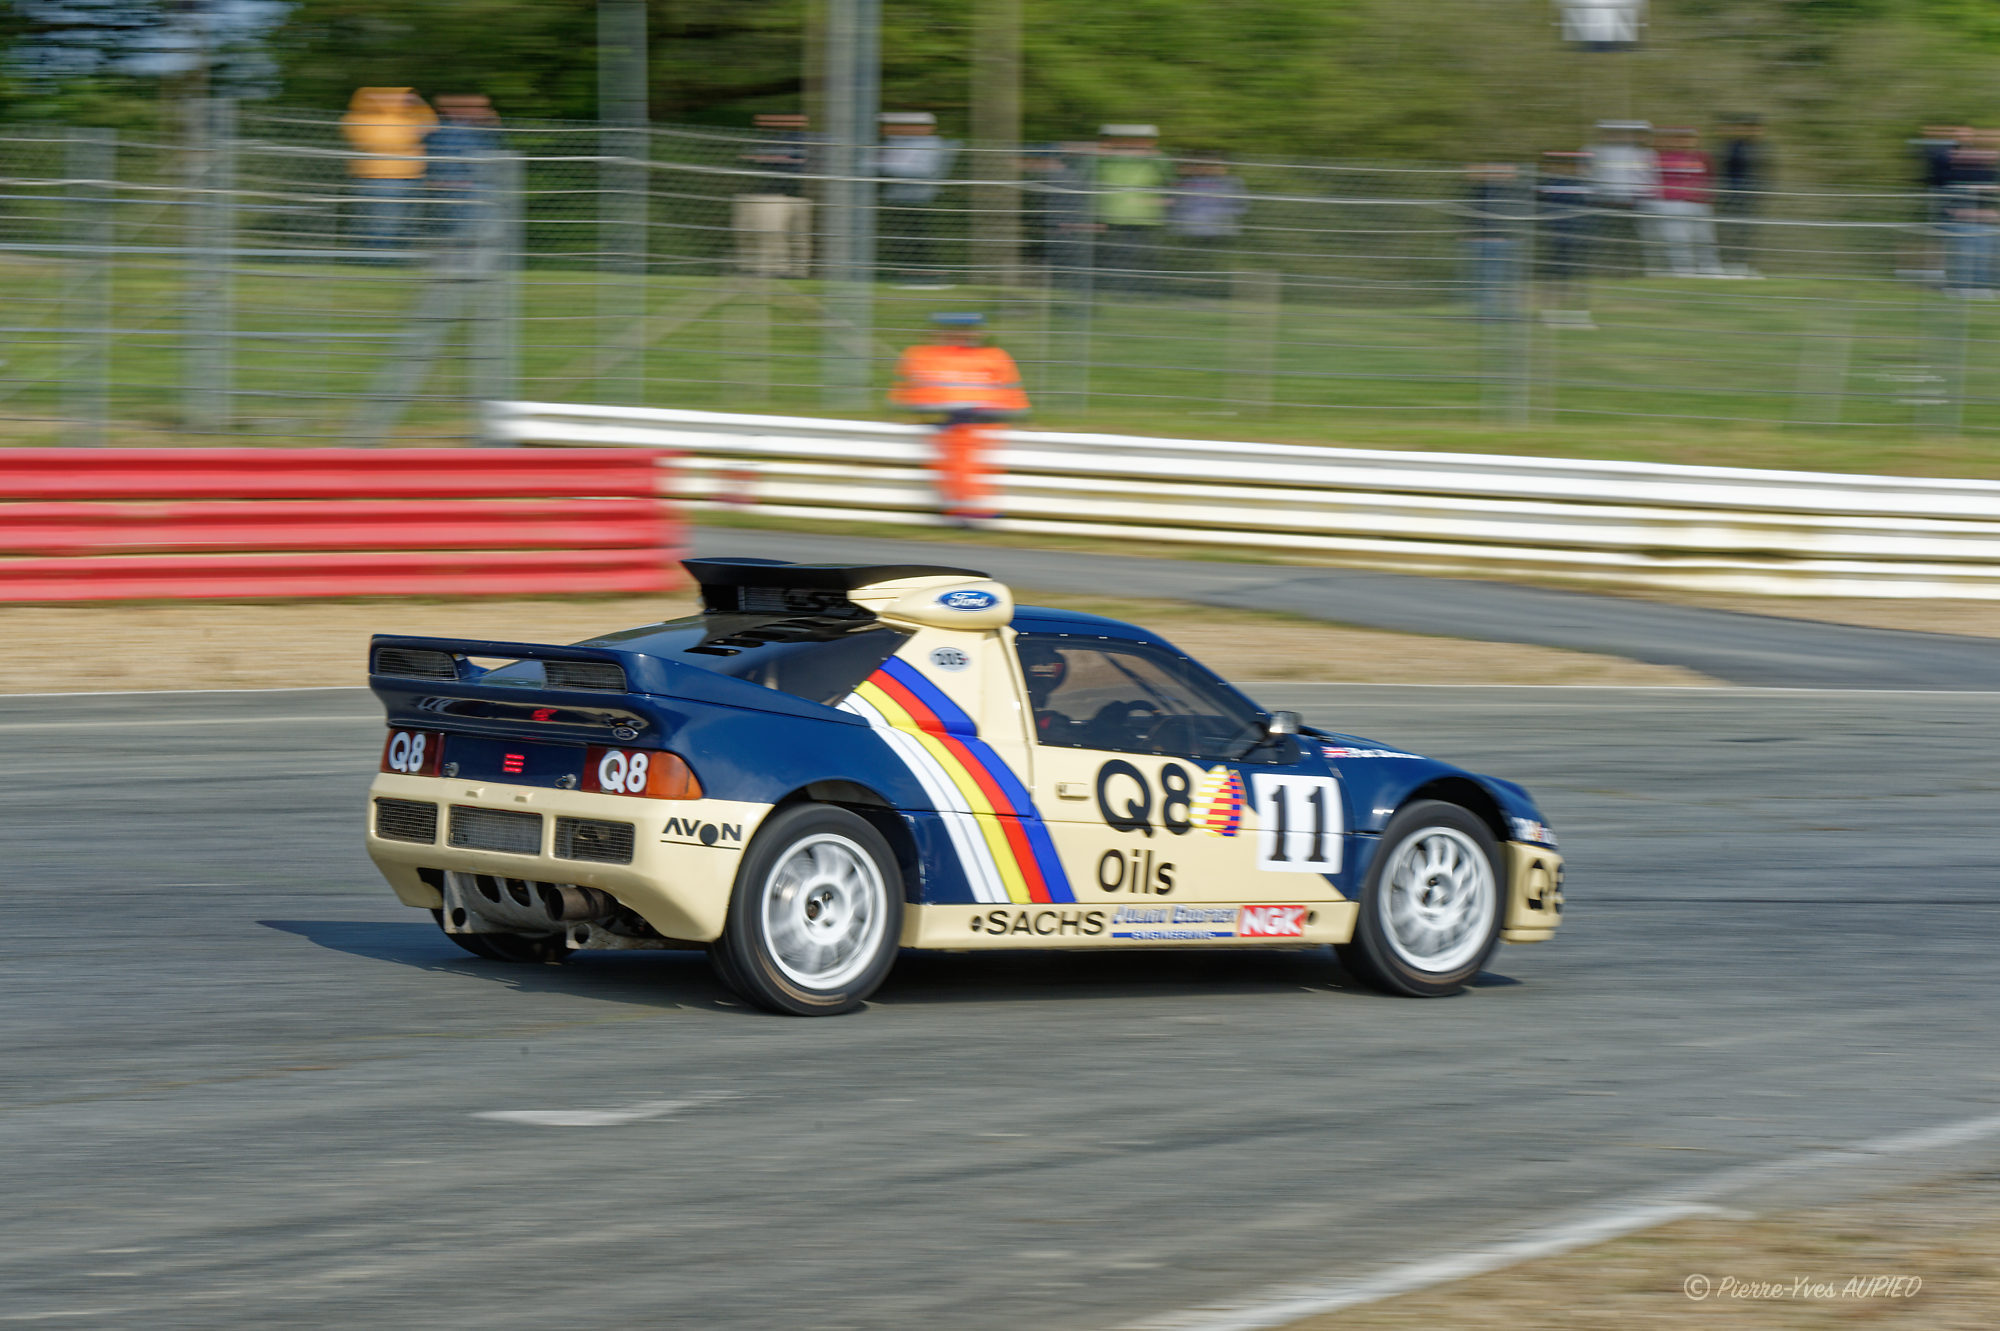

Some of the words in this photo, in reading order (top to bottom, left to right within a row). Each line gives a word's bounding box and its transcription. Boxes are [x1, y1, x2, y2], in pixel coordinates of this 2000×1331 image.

[948, 592, 990, 607] Ford
[389, 731, 427, 773] Q8
[598, 750, 649, 794] Q8
[1096, 758, 1191, 838] Q8
[661, 817, 742, 846] AVON
[1270, 784, 1329, 863] 11
[1098, 848, 1176, 895] Oils
[987, 910, 1105, 936] SACHS
[1240, 906, 1306, 936] NGK
